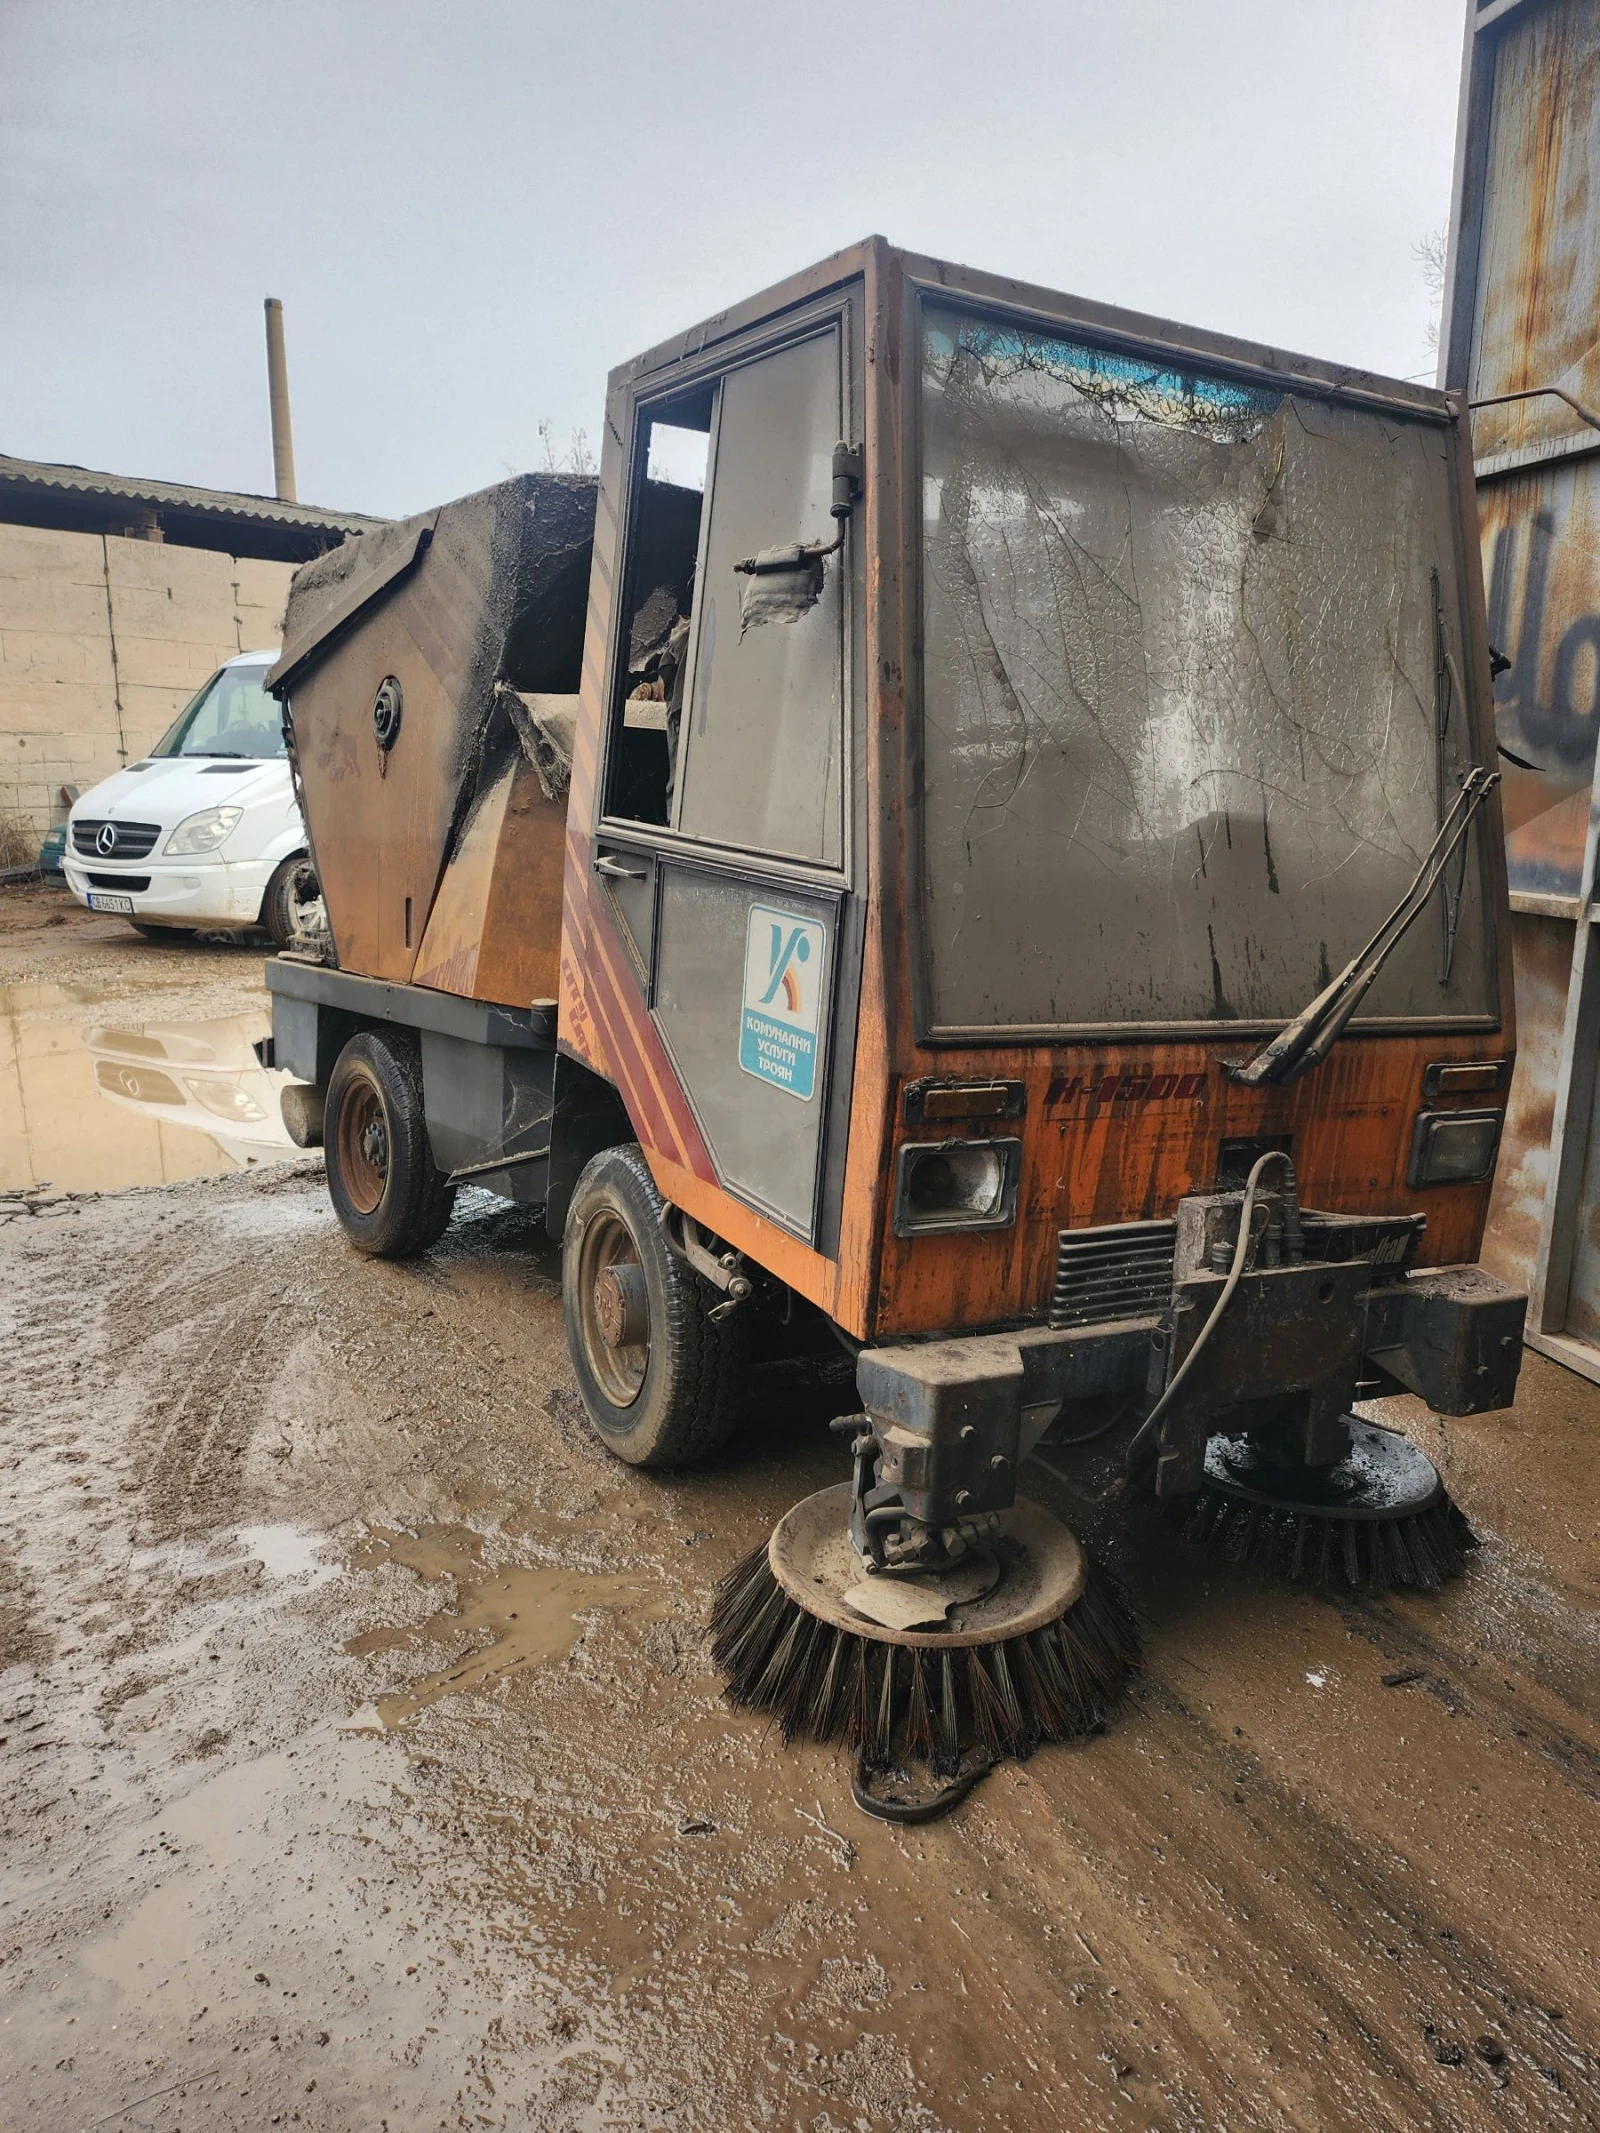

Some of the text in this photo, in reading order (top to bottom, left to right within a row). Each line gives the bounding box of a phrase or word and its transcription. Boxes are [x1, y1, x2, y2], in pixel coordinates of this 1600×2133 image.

[746, 1017, 811, 1054] КОМУНАЛНИ
[757, 1038, 796, 1067] УСЛУГИ
[758, 1055, 793, 1082] ТРОЯН
